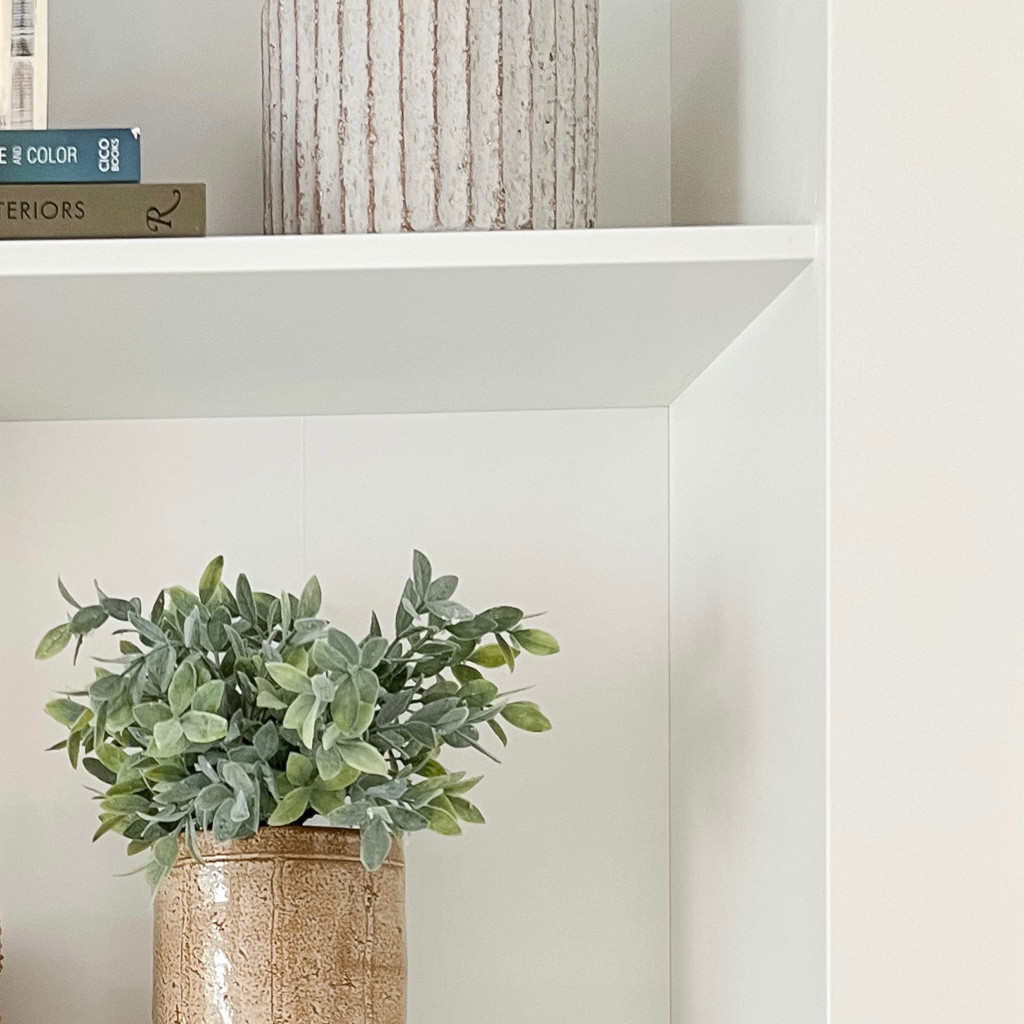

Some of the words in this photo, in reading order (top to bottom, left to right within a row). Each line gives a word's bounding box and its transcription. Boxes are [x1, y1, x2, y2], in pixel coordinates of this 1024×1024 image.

[13, 146, 22, 165] AND
[27, 146, 77, 164] COLOR
[99, 138, 110, 172] CICO
[111, 138, 119, 172] BOOKS
